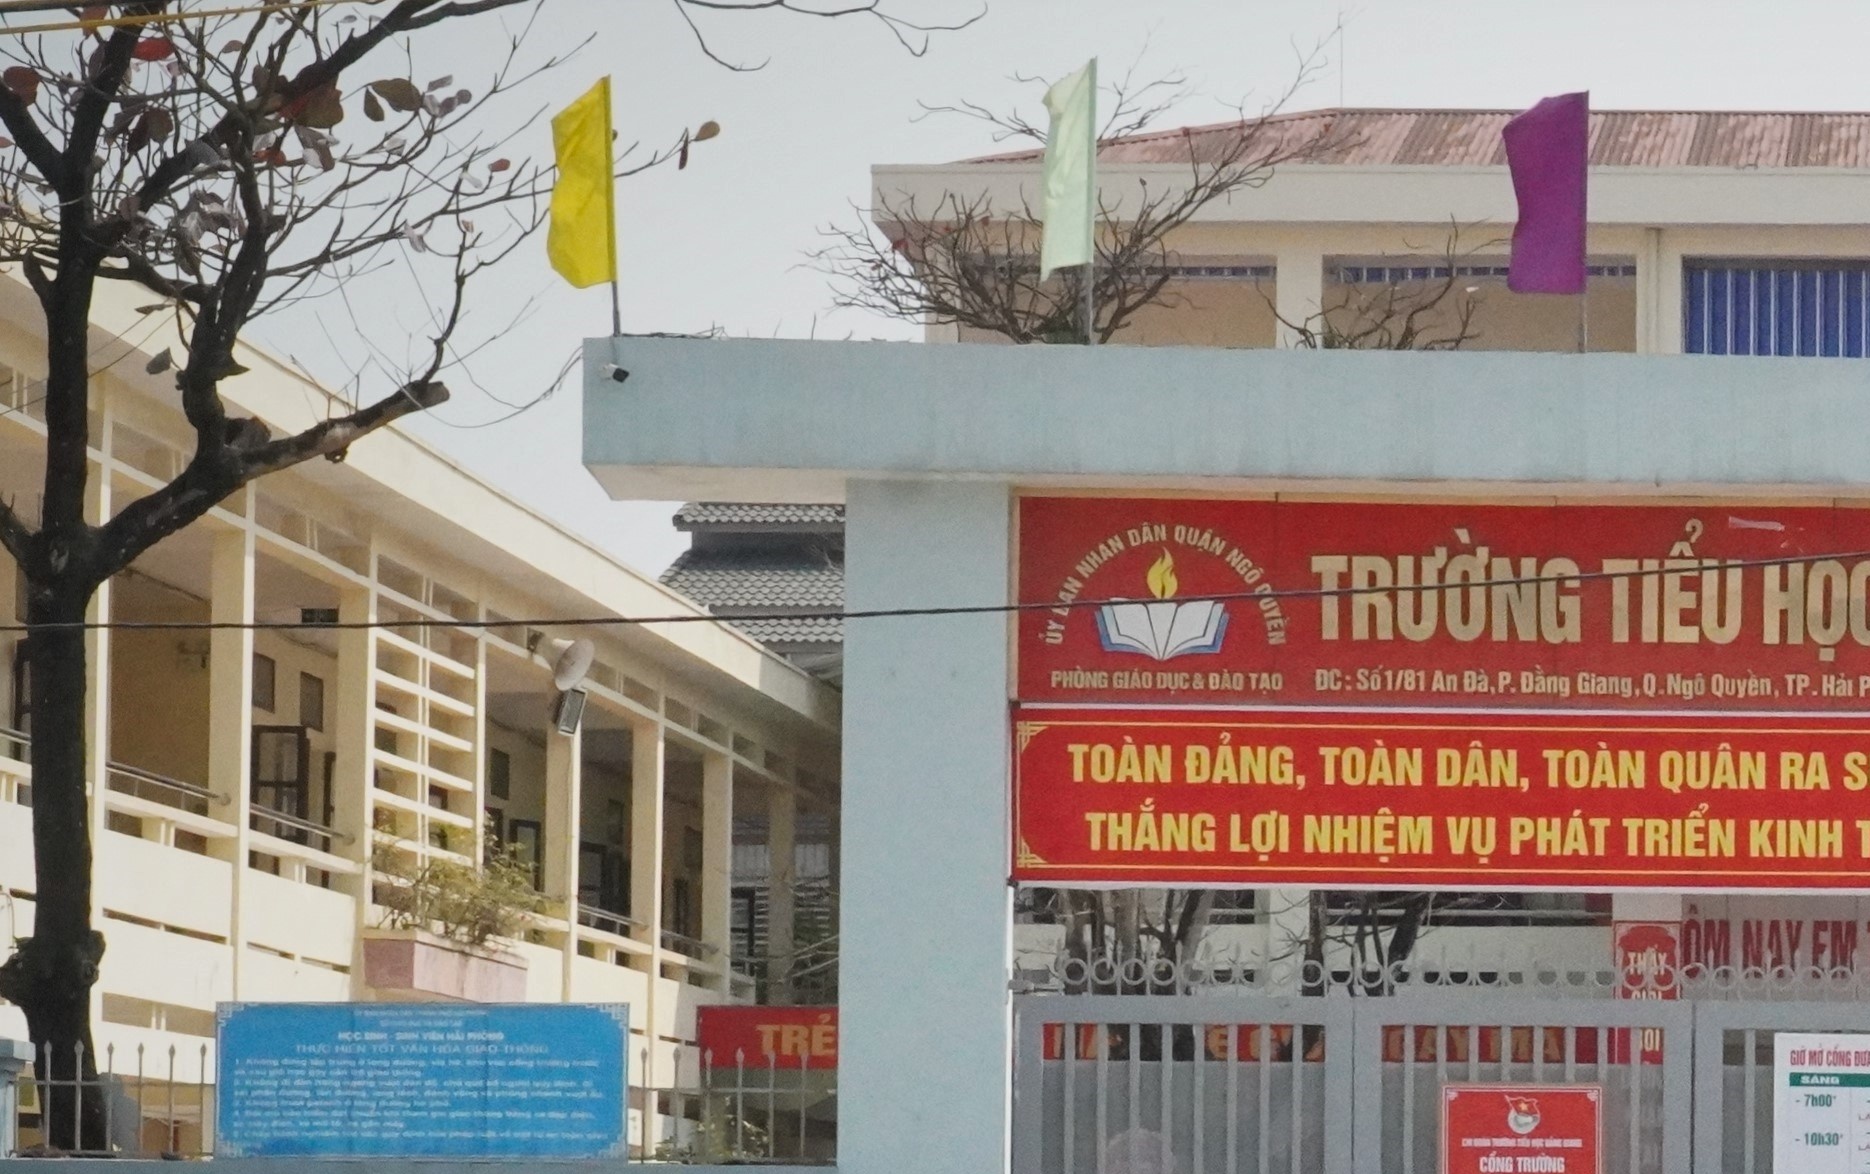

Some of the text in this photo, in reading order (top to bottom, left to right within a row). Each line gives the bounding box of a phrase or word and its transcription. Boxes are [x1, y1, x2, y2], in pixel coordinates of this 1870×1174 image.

[1127, 521, 1167, 547] DÂN
[1174, 524, 1228, 556] QUẬN
[1312, 527, 1582, 645] TRƯỜNG
[1603, 517, 1743, 645] TIỂU
[1050, 666, 1284, 696] PHÒNG GIÁO DỤC & ĐÀO TẠO
[1356, 664, 1384, 692] Số
[1386, 668, 1426, 692] 1/81
[1432, 671, 1458, 692] An
[1520, 664, 1571, 697] Đằng
[1666, 673, 1706, 700] Ngô
[1822, 671, 1854, 697] Hải
[1068, 734, 1172, 785] TOÀN
[1184, 731, 1306, 792] ĐẢNG,
[1319, 739, 1422, 787] TOÀN
[1437, 741, 1530, 793] DÂN,
[1543, 741, 1648, 790] TOÀN
[1659, 743, 1766, 793] QUÂN
[1781, 753, 1830, 791] RA
[1086, 797, 1216, 854] THẮNG
[1229, 811, 1289, 862] LỢI
[1303, 806, 1433, 863] NHIỆM
[1447, 817, 1496, 864] VỤ
[1510, 808, 1610, 857] PHÁT
[1623, 803, 1736, 857] TRIỂN
[1749, 818, 1842, 859] KINH
[1742, 918, 1804, 979] NAY
[1812, 918, 1858, 980] EM
[1479, 1150, 1566, 1174] CỔNG TRƯỜNG
